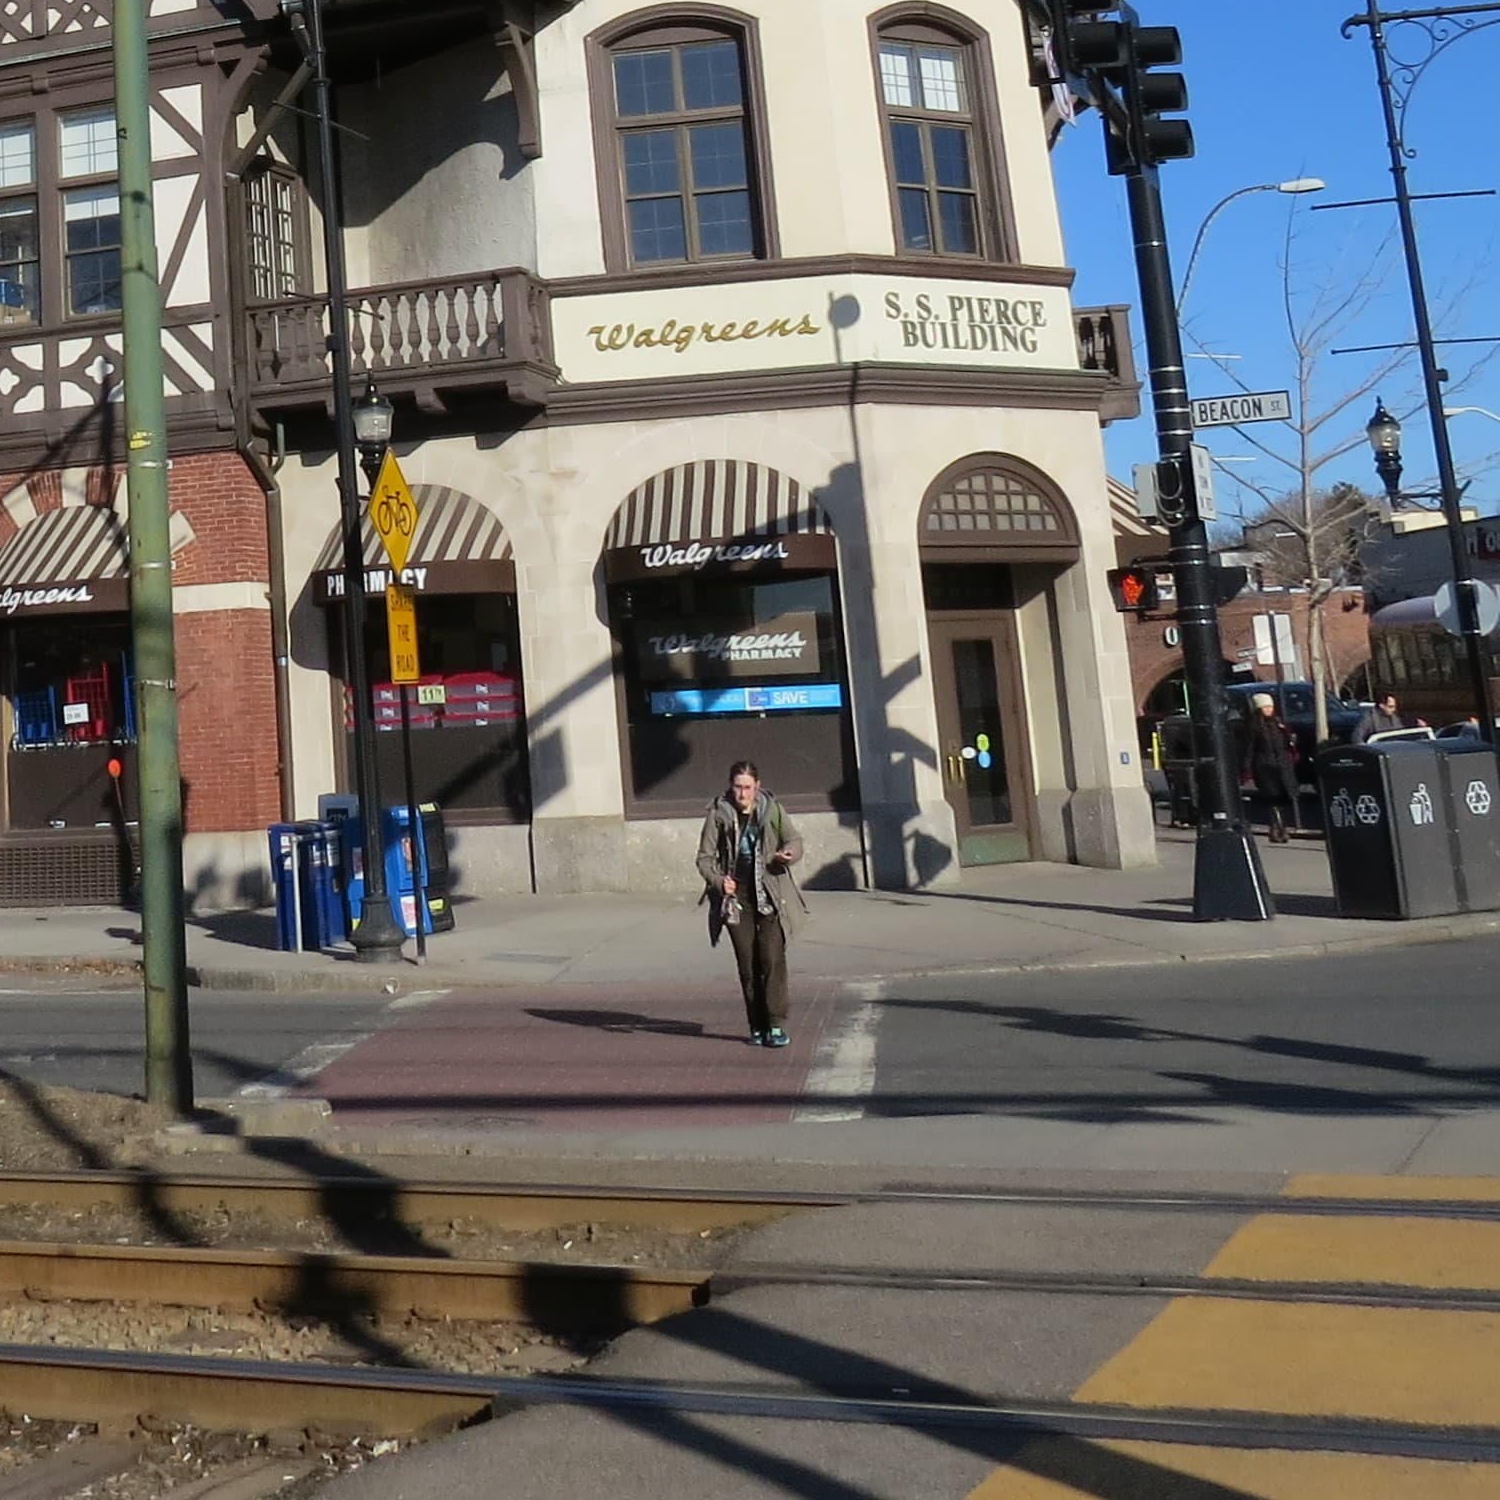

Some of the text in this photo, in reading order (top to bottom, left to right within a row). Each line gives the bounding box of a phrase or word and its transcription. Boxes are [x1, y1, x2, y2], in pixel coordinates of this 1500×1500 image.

[883, 291, 1047, 328] S. S. PIERCE
[587, 313, 822, 354] Walgreens
[901, 319, 1039, 354] BUILDING
[1198, 398, 1263, 423] BEACON
[641, 541, 790, 571] Walgreens
[649, 630, 808, 660] Walgreens
[722, 647, 803, 661] PHARMACY
[772, 691, 809, 706] SAVE
